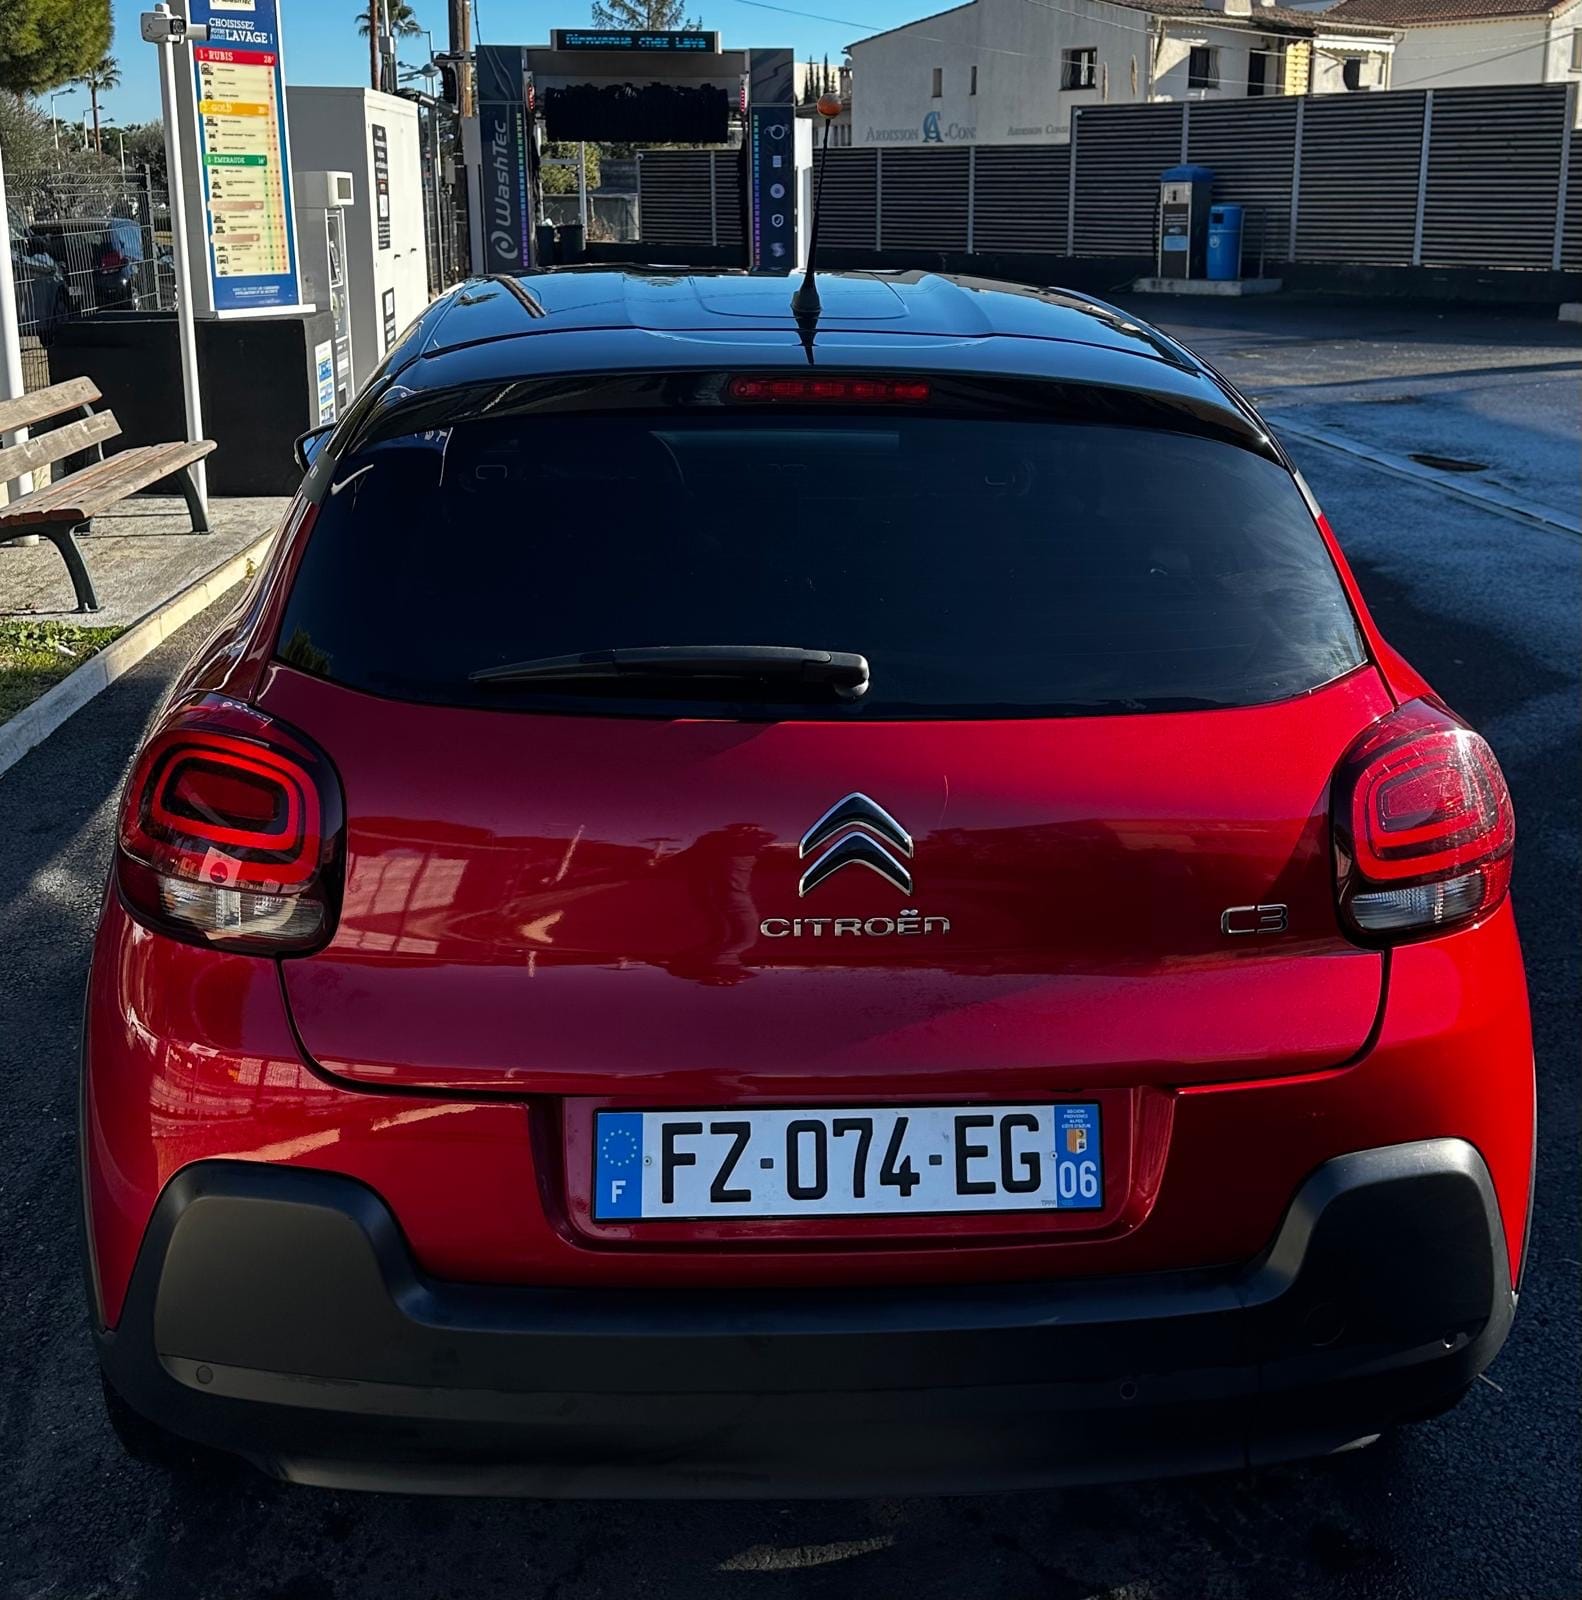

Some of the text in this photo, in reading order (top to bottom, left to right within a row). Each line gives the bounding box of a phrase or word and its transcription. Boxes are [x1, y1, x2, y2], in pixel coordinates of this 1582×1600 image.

[209, 18, 254, 30] CHOISISSEZ
[226, 29, 268, 44] LAVAGE
[208, 51, 234, 61] RUBIS
[492, 119, 512, 227] WashTec
[759, 908, 951, 938] CITROËN
[1220, 903, 1289, 935] C3
[611, 1180, 626, 1203] F
[1059, 1160, 1098, 1199] 06
